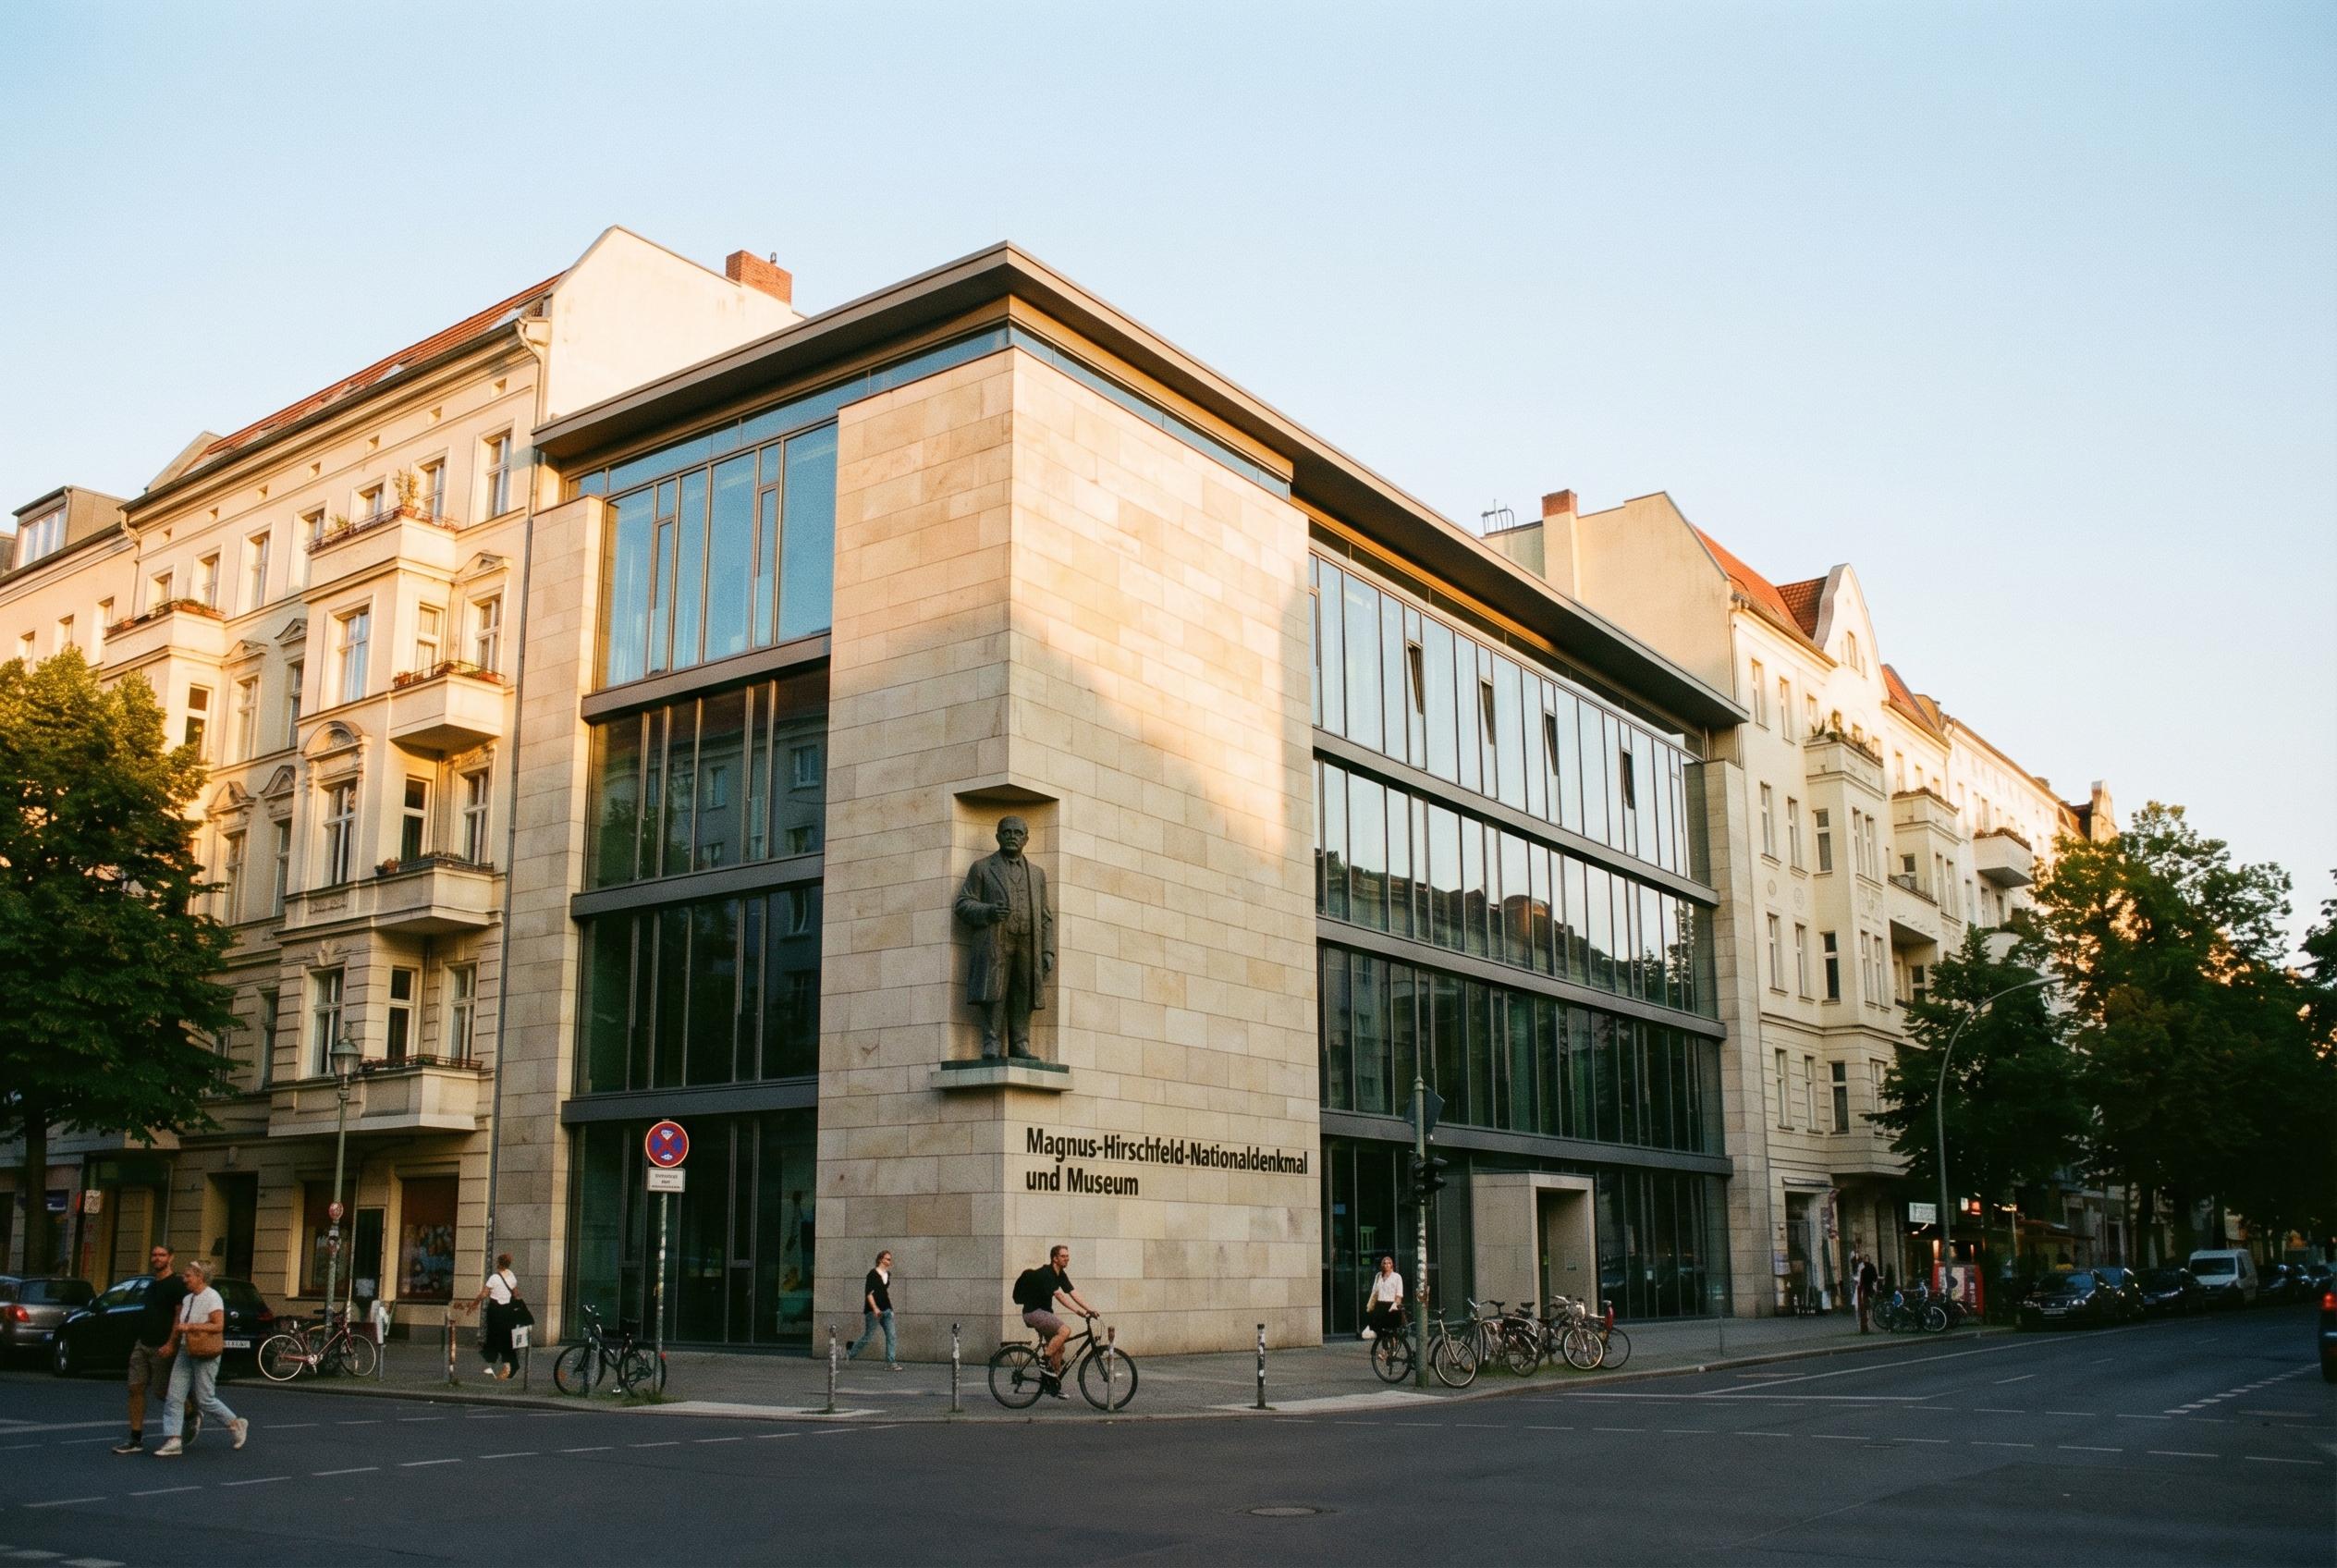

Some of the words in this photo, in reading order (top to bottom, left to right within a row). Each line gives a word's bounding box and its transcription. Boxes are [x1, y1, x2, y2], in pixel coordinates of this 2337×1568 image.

[1026, 1127, 1308, 1174] Magnus-Hirschfeld-Nationaldenkmal
[1026, 1165, 1060, 1192] und
[1067, 1167, 1139, 1195] Museum
